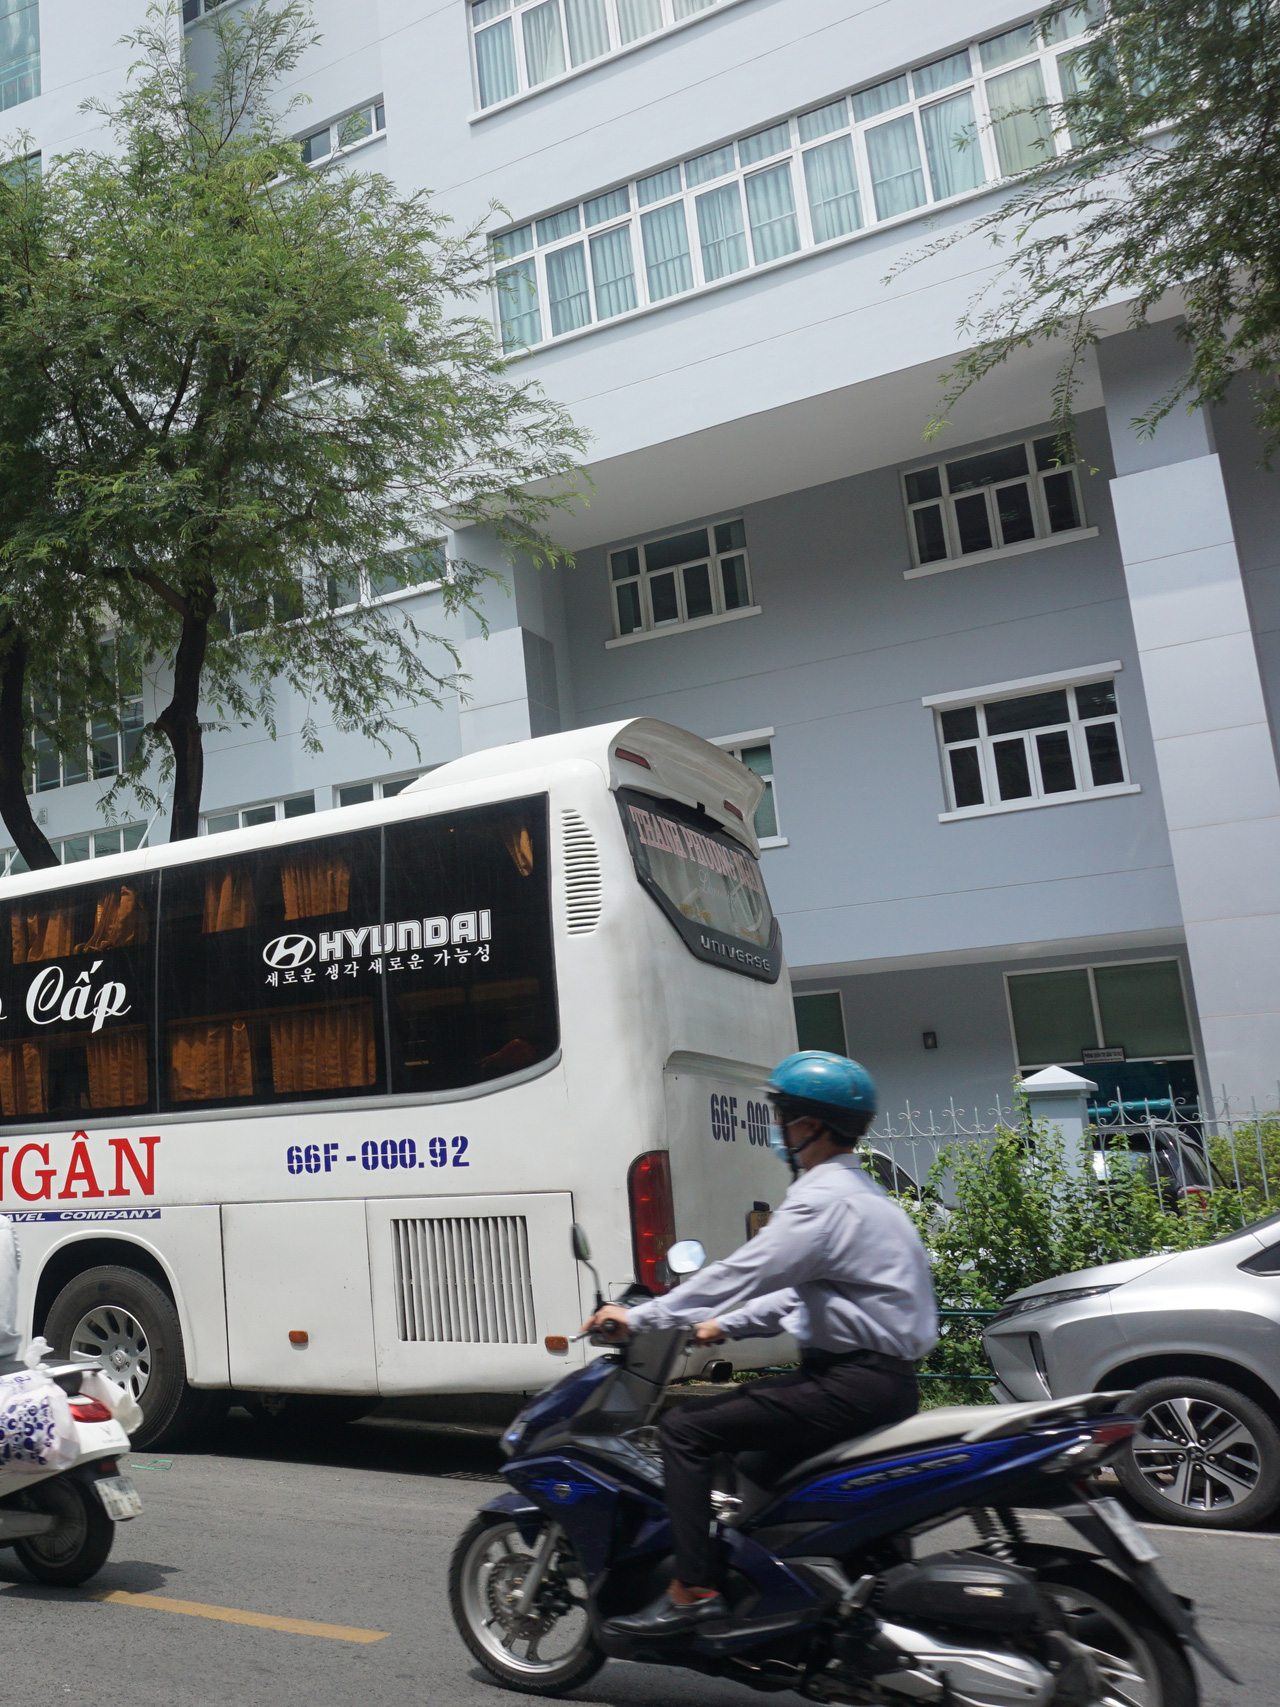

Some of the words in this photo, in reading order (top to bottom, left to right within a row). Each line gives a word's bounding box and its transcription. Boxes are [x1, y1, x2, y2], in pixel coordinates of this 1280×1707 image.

[628, 804, 688, 859] THANH
[319, 908, 492, 962] HYUNDAI
[700, 934, 772, 973] UNIVERSE
[264, 966, 317, 988] 새로운
[324, 961, 360, 981] 생각
[367, 952, 425, 976] 새로운
[432, 943, 492, 967] 가능성
[25, 959, 132, 1034] Cấp
[286, 1135, 470, 1175] 66F-000.92
[6, 1211, 46, 1222] AVEL
[59, 1208, 160, 1220] COMPANY
